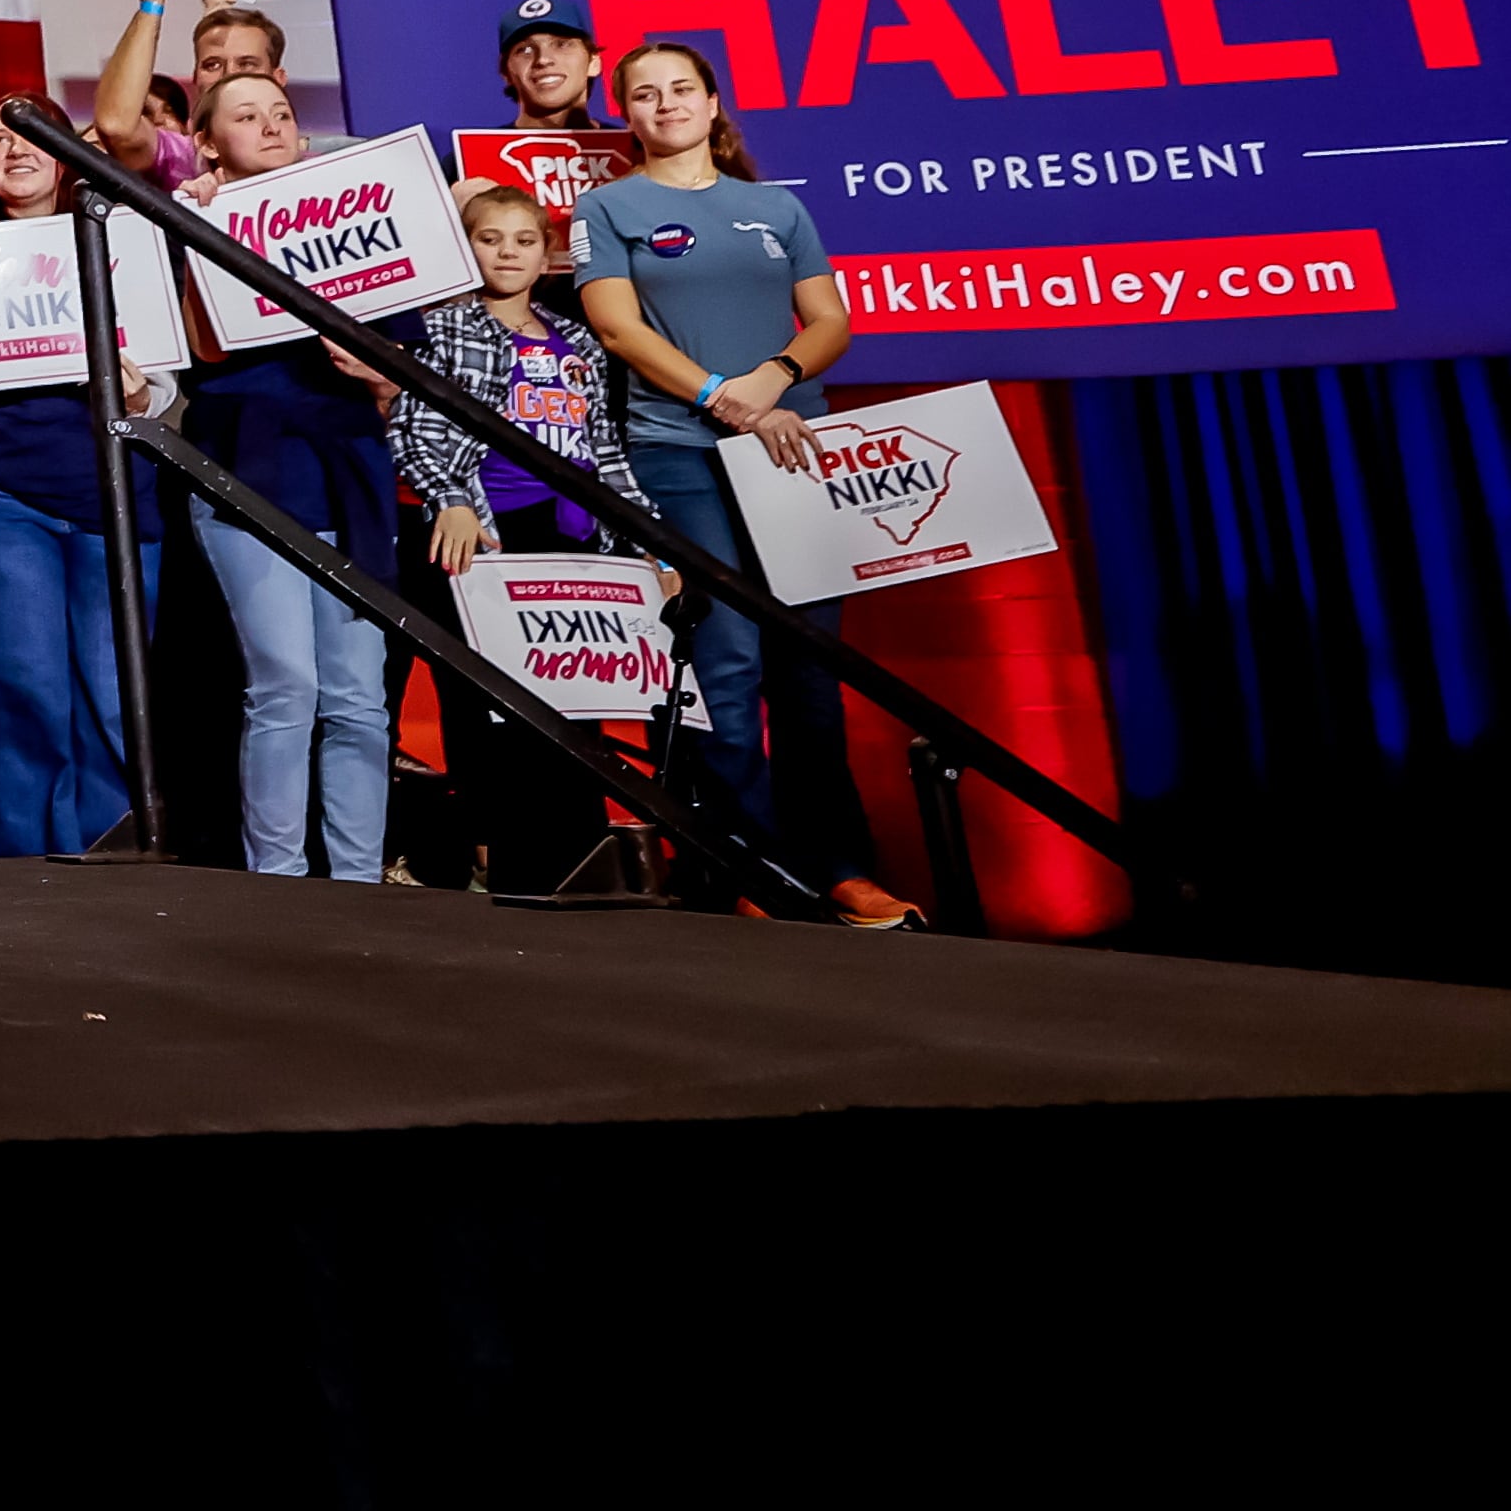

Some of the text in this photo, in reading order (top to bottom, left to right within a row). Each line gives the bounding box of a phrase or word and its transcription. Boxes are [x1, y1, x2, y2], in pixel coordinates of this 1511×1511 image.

[530, 155, 613, 180] PICK
[844, 141, 1266, 197] FOR PRESIDENT
[533, 179, 606, 207] NIK
[229, 182, 393, 261] Women
[281, 216, 402, 279] NIKKI
[5, 291, 77, 329] NIK
[817, 435, 911, 479] PICK
[824, 460, 938, 510] NIKKI
[517, 611, 628, 643] NIKKI
[524, 635, 670, 695] Women
